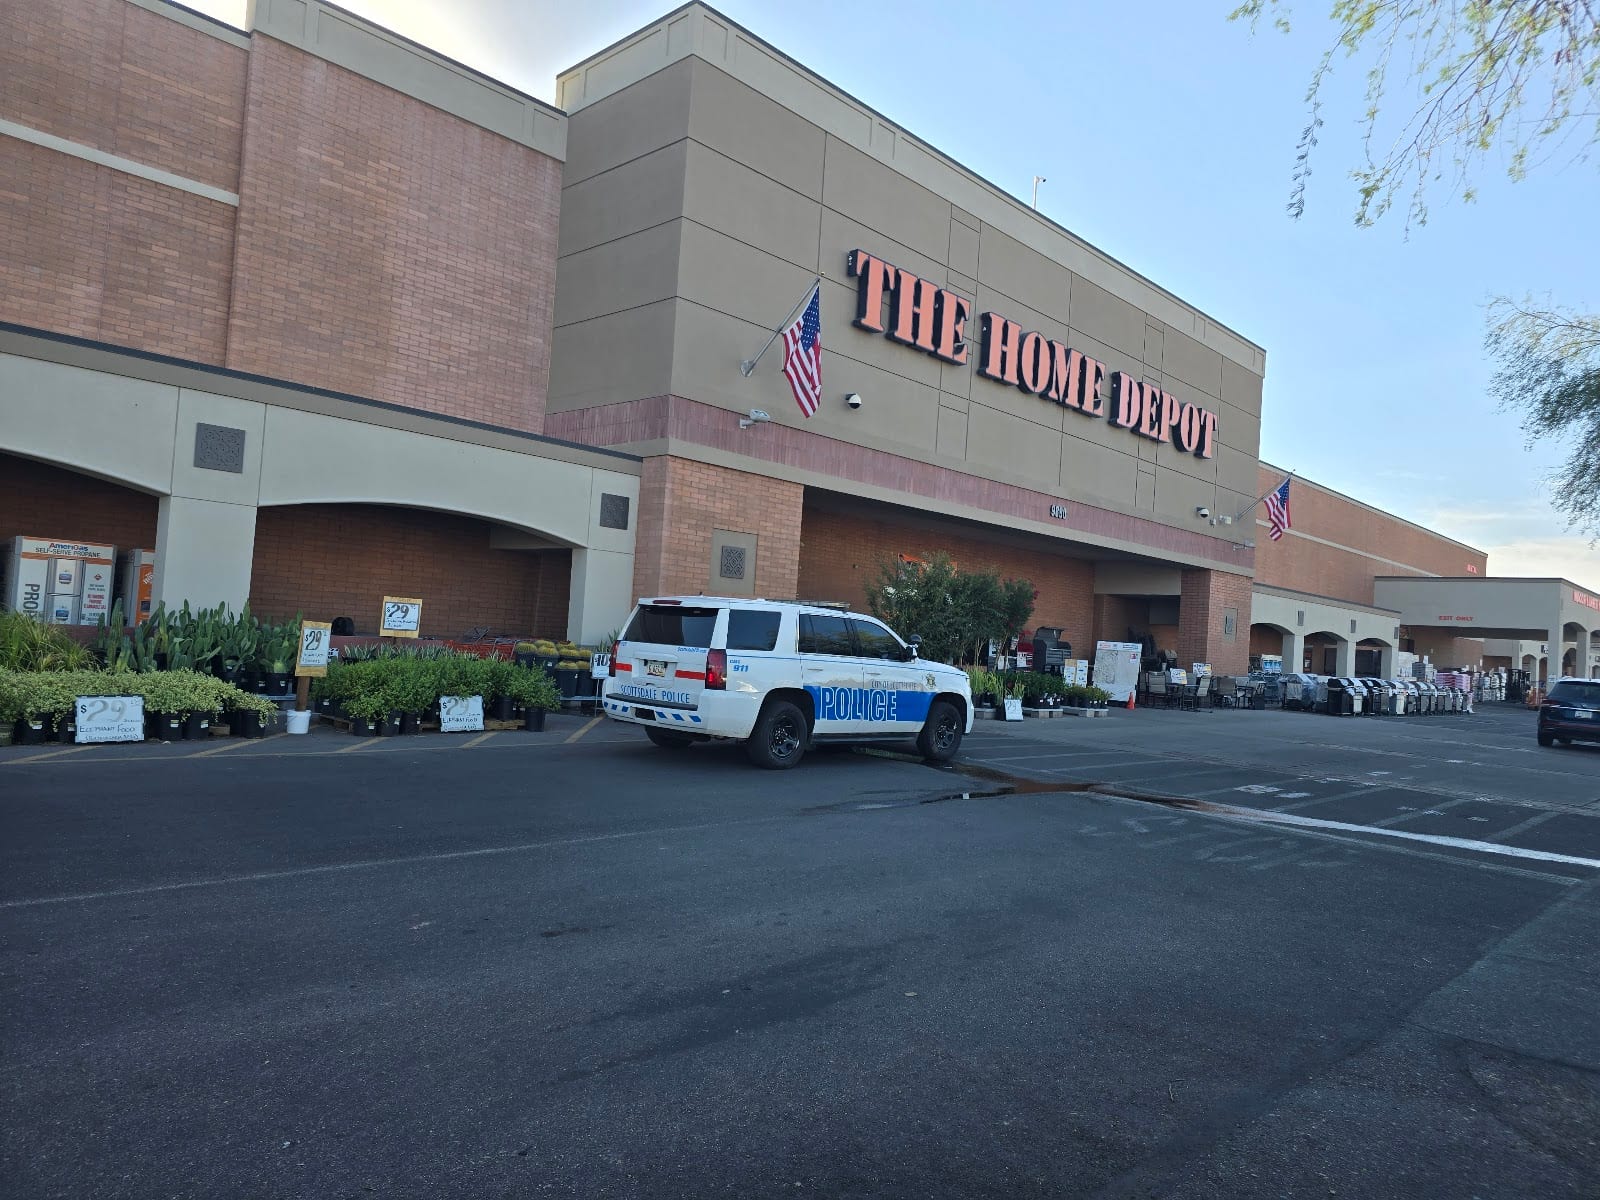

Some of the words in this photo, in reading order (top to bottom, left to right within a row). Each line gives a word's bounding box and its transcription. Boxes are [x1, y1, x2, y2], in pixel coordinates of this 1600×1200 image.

[847, 249, 970, 366] THE
[977, 311, 1107, 418] HOME
[1108, 371, 1218, 459] DEPOT
[35, 547, 71, 556] SELF-SERVE
[72, 550, 101, 558] PROPANE
[49, 542, 88, 552] AmeriGas
[620, 684, 657, 700] SCOTTSDALE
[661, 690, 690, 704] POLICE
[820, 687, 897, 721] POLICE
[80, 699, 128, 722] $29
